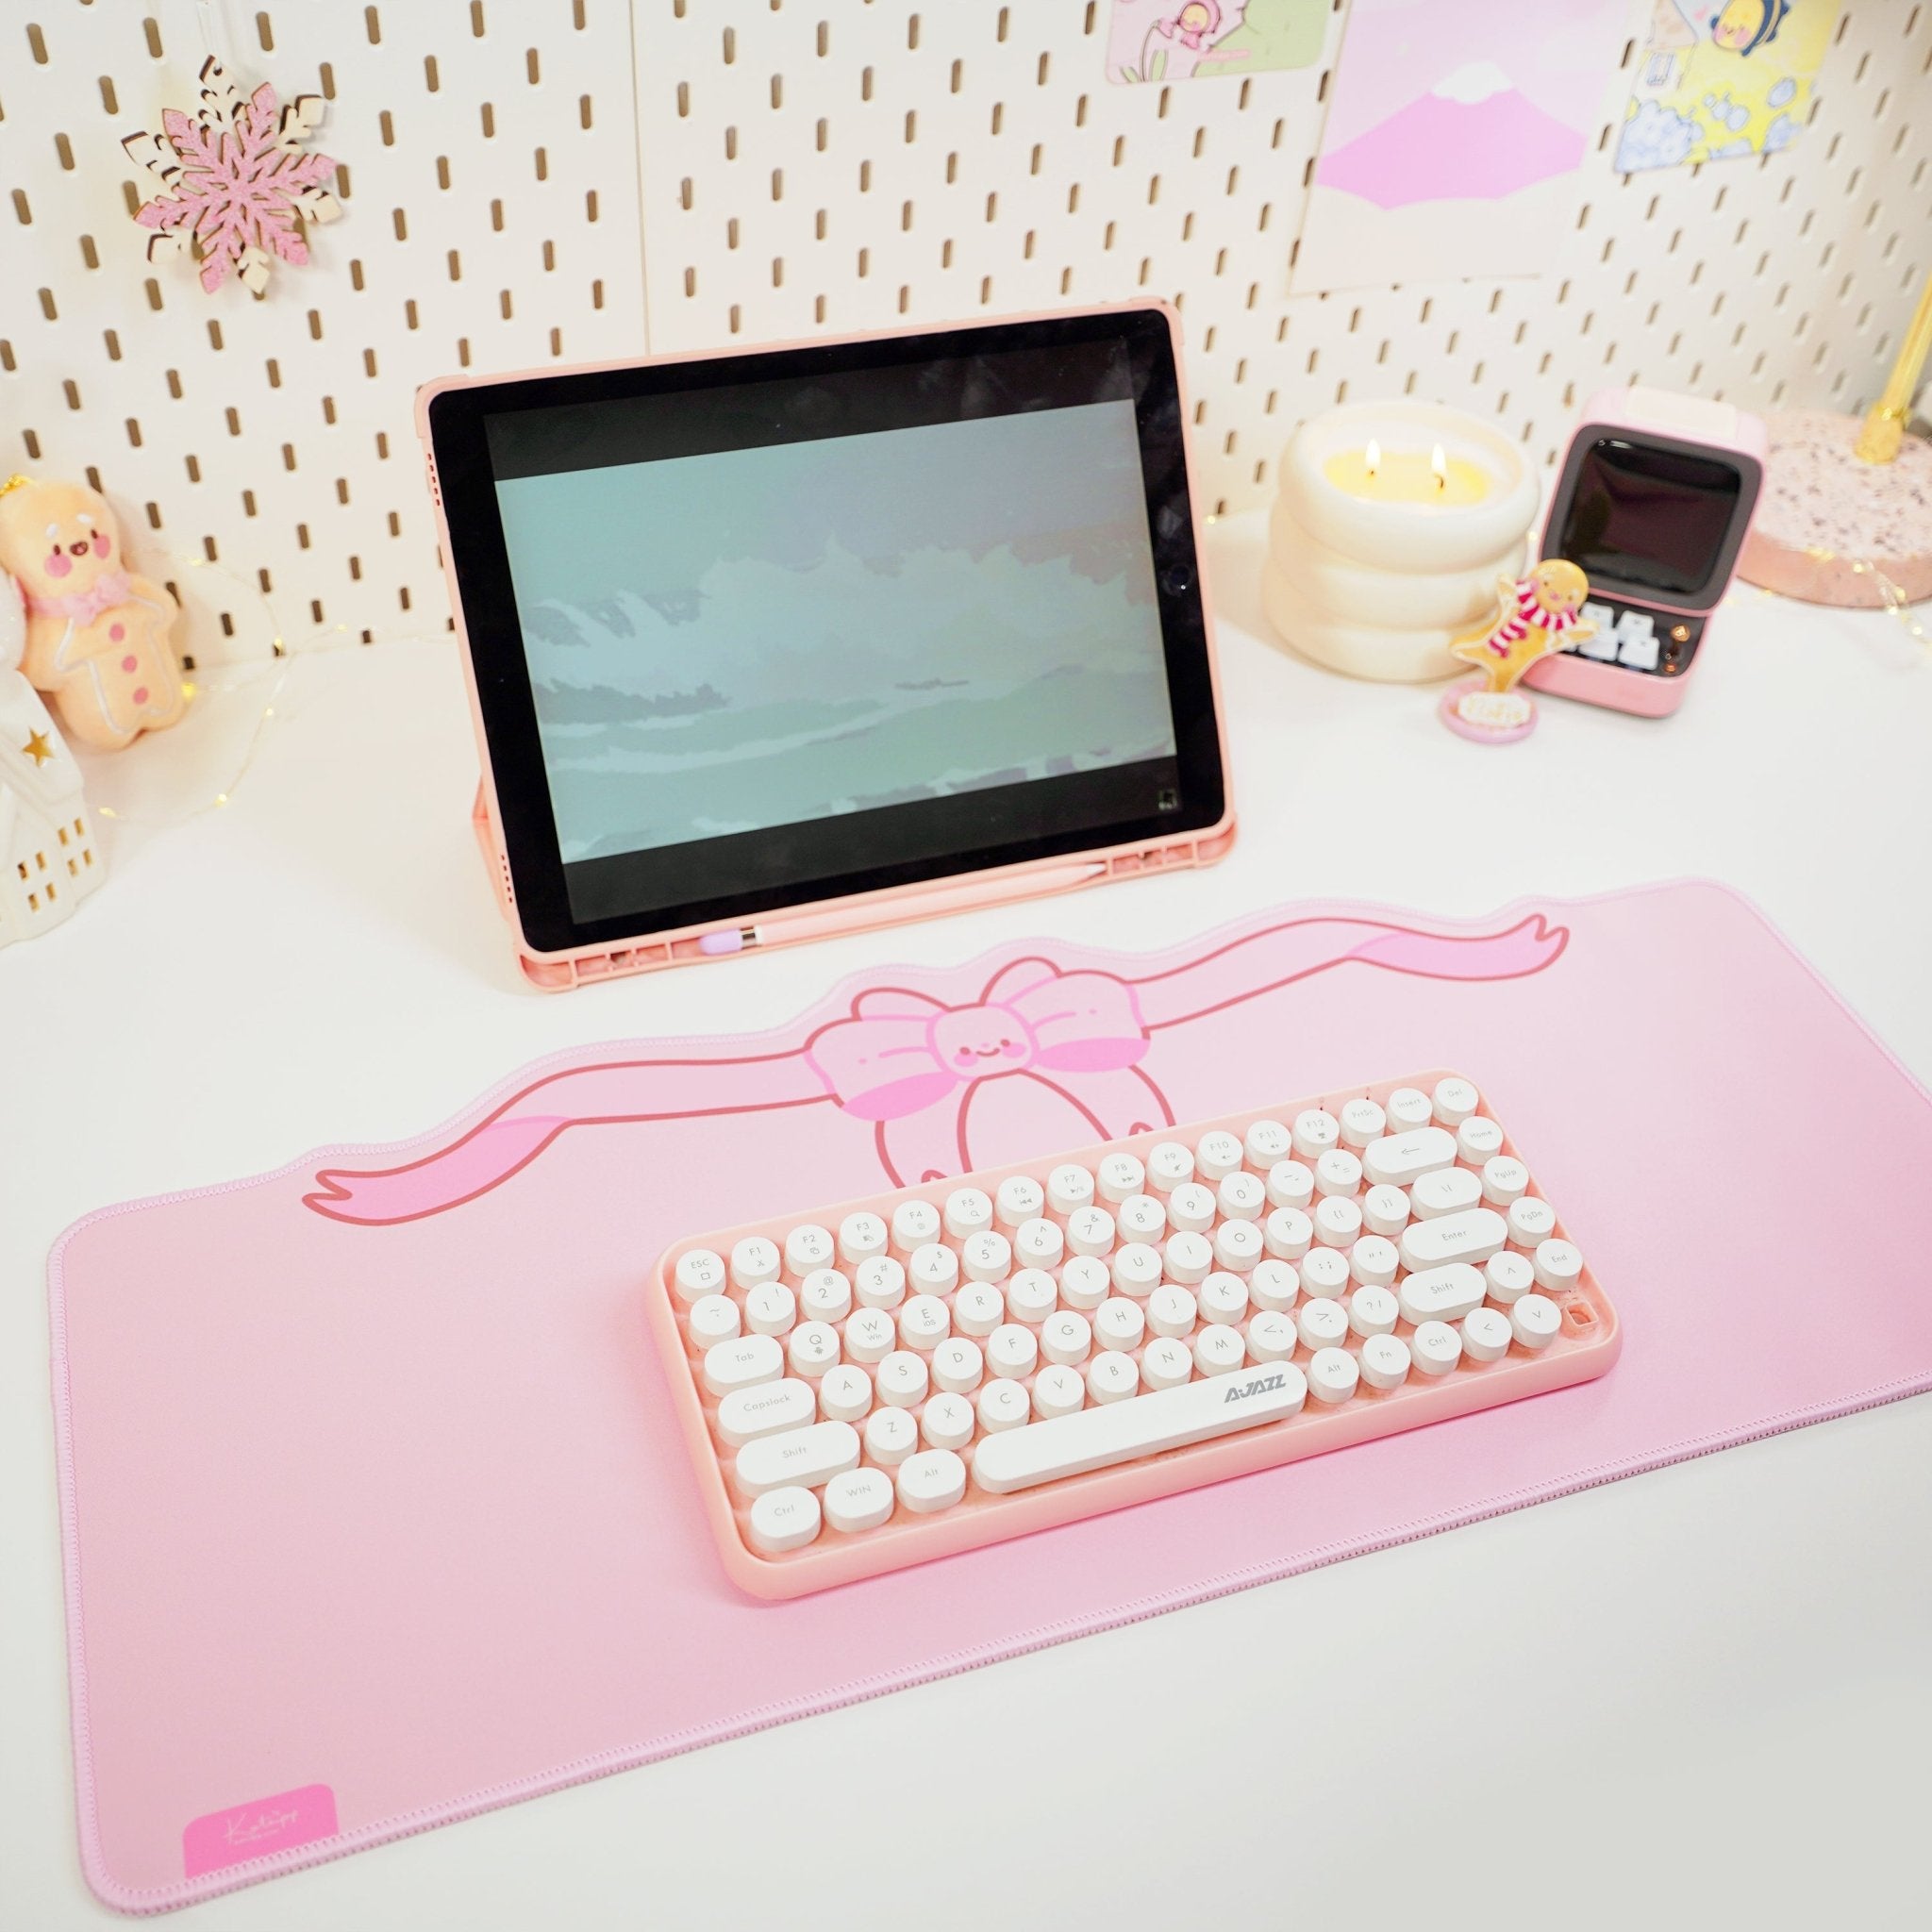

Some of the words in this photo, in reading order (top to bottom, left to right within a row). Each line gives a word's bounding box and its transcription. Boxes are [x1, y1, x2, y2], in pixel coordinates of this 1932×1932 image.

[1446, 1088, 1463, 1098] Del
[1396, 1098, 1422, 1108] Insert
[1305, 1118, 1325, 1129] F12
[1257, 1129, 1277, 1141] F11
[1469, 1130, 1493, 1139] Home
[1208, 1139, 1230, 1152] F10
[1163, 1152, 1177, 1161] F9
[1114, 1162, 1128, 1173] F8
[1063, 1174, 1076, 1184] F7
[1493, 1169, 1517, 1179] PgUp
[1012, 1186, 1027, 1195] F6
[1236, 1189, 1246, 1200] 0
[960, 1197, 974, 1208] F5
[1186, 1200, 1195, 1211] 9
[908, 1209, 924, 1220] F4
[1090, 1213, 1100, 1223] &
[1135, 1212, 1146, 1224] 8
[1520, 1210, 1544, 1221] PgDn
[856, 1222, 870, 1231] F3
[1083, 1224, 1092, 1236] 7
[1284, 1221, 1293, 1231] P
[802, 1233, 816, 1244] F2
[1234, 1232, 1246, 1243] O
[1441, 1230, 1467, 1241] Enter
[983, 1238, 996, 1248] %
[1034, 1236, 1043, 1247] 6
[748, 1246, 761, 1257] F1
[936, 1250, 943, 1259] $
[981, 1248, 991, 1260] 5
[690, 1257, 710, 1270] ESC
[1132, 1256, 1144, 1268] U
[1551, 1253, 1568, 1263] End
[879, 1262, 889, 1273] #
[929, 1262, 939, 1273] 4
[873, 1274, 884, 1286] 3
[1080, 1269, 1090, 1280] Y
[1271, 1274, 1281, 1284] L
[823, 1275, 835, 1287] @
[1027, 1281, 1037, 1292] T
[818, 1287, 829, 1299] 2
[1218, 1285, 1230, 1297] K
[1429, 1282, 1455, 1294] Shift
[974, 1295, 985, 1307] R
[921, 1307, 931, 1319] E
[1115, 1310, 1127, 1323] H
[861, 1320, 878, 1332] W
[923, 1319, 937, 1327] iOS
[1060, 1324, 1074, 1336] G
[808, 1334, 823, 1345] Q
[866, 1333, 883, 1341] Win
[1427, 1335, 1448, 1347] Ctrl
[1008, 1338, 1017, 1349] F
[1215, 1339, 1229, 1350] M
[734, 1352, 755, 1362] Tab
[952, 1352, 964, 1364] D
[1161, 1351, 1175, 1364] N
[1378, 1350, 1392, 1359] Fn
[897, 1365, 908, 1376] S
[1108, 1365, 1119, 1376] B
[1327, 1364, 1341, 1374] Alt
[842, 1379, 854, 1391] A
[1053, 1378, 1063, 1390] V
[742, 1393, 791, 1412] Capslock
[999, 1392, 1011, 1405] C
[943, 1407, 955, 1419] X
[886, 1421, 898, 1434] Z
[782, 1446, 807, 1458] Shift
[924, 1468, 939, 1480] Alt
[845, 1484, 872, 1497] WIN
[774, 1504, 795, 1517] Ctrl
